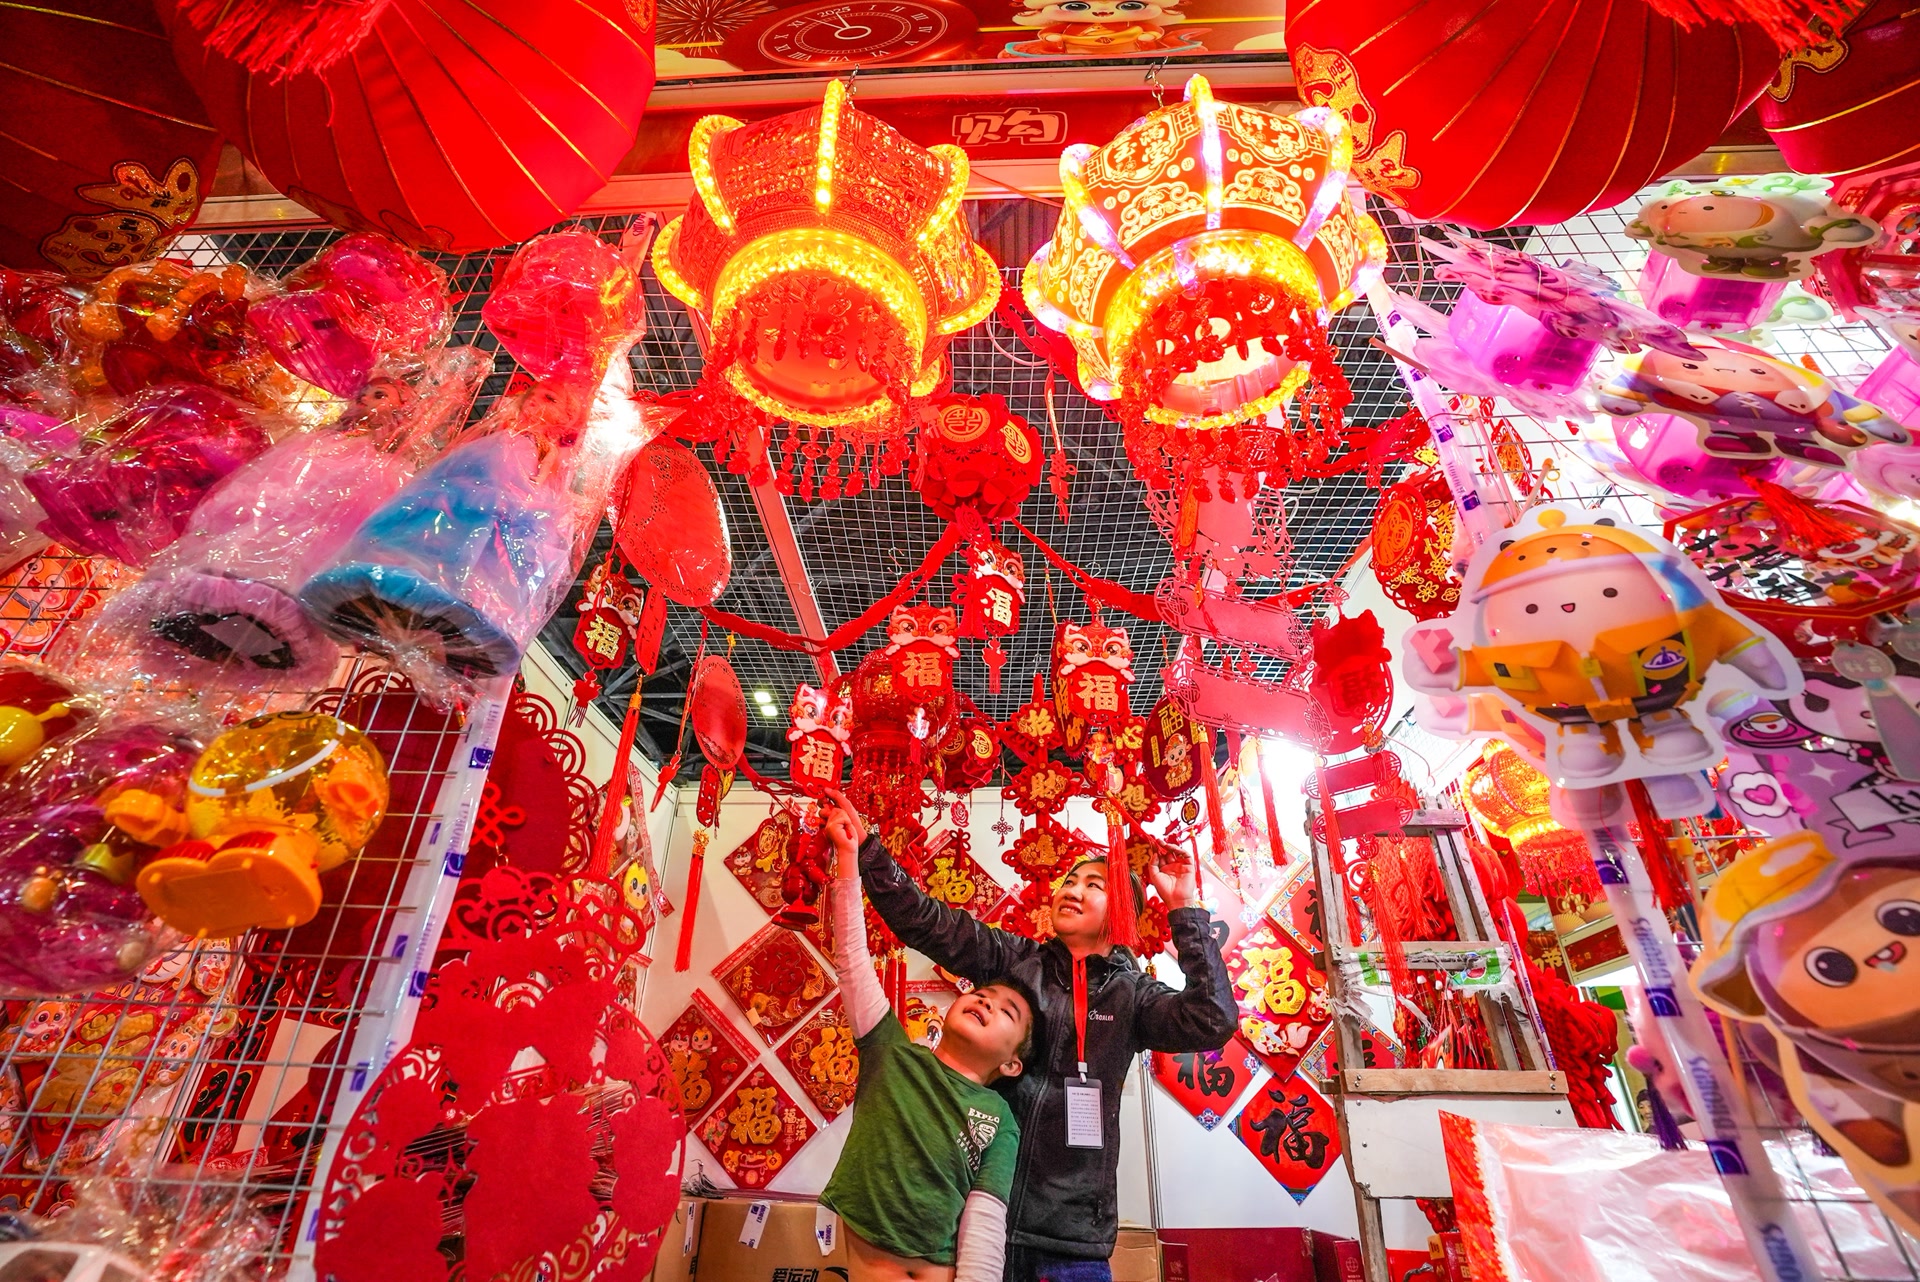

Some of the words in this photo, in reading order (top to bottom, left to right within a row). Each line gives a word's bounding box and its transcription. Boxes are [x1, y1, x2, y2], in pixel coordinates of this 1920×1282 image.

[816, 6, 851, 18] 2025
[980, 587, 1013, 628] 福
[584, 614, 622, 660] 福
[900, 651, 942, 687] 福
[1076, 674, 1119, 712] 福
[799, 735, 836, 778] 福
[1115, 725, 1143, 750] 心
[1121, 783, 1152, 811] 想
[926, 856, 976, 904] 福
[1238, 946, 1307, 1015] 福
[809, 1026, 859, 1085] 福
[1174, 1049, 1235, 1098] 福
[728, 1086, 783, 1145] 福
[783, 1108, 797, 1124] 福
[1250, 1089, 1330, 1170] 福
